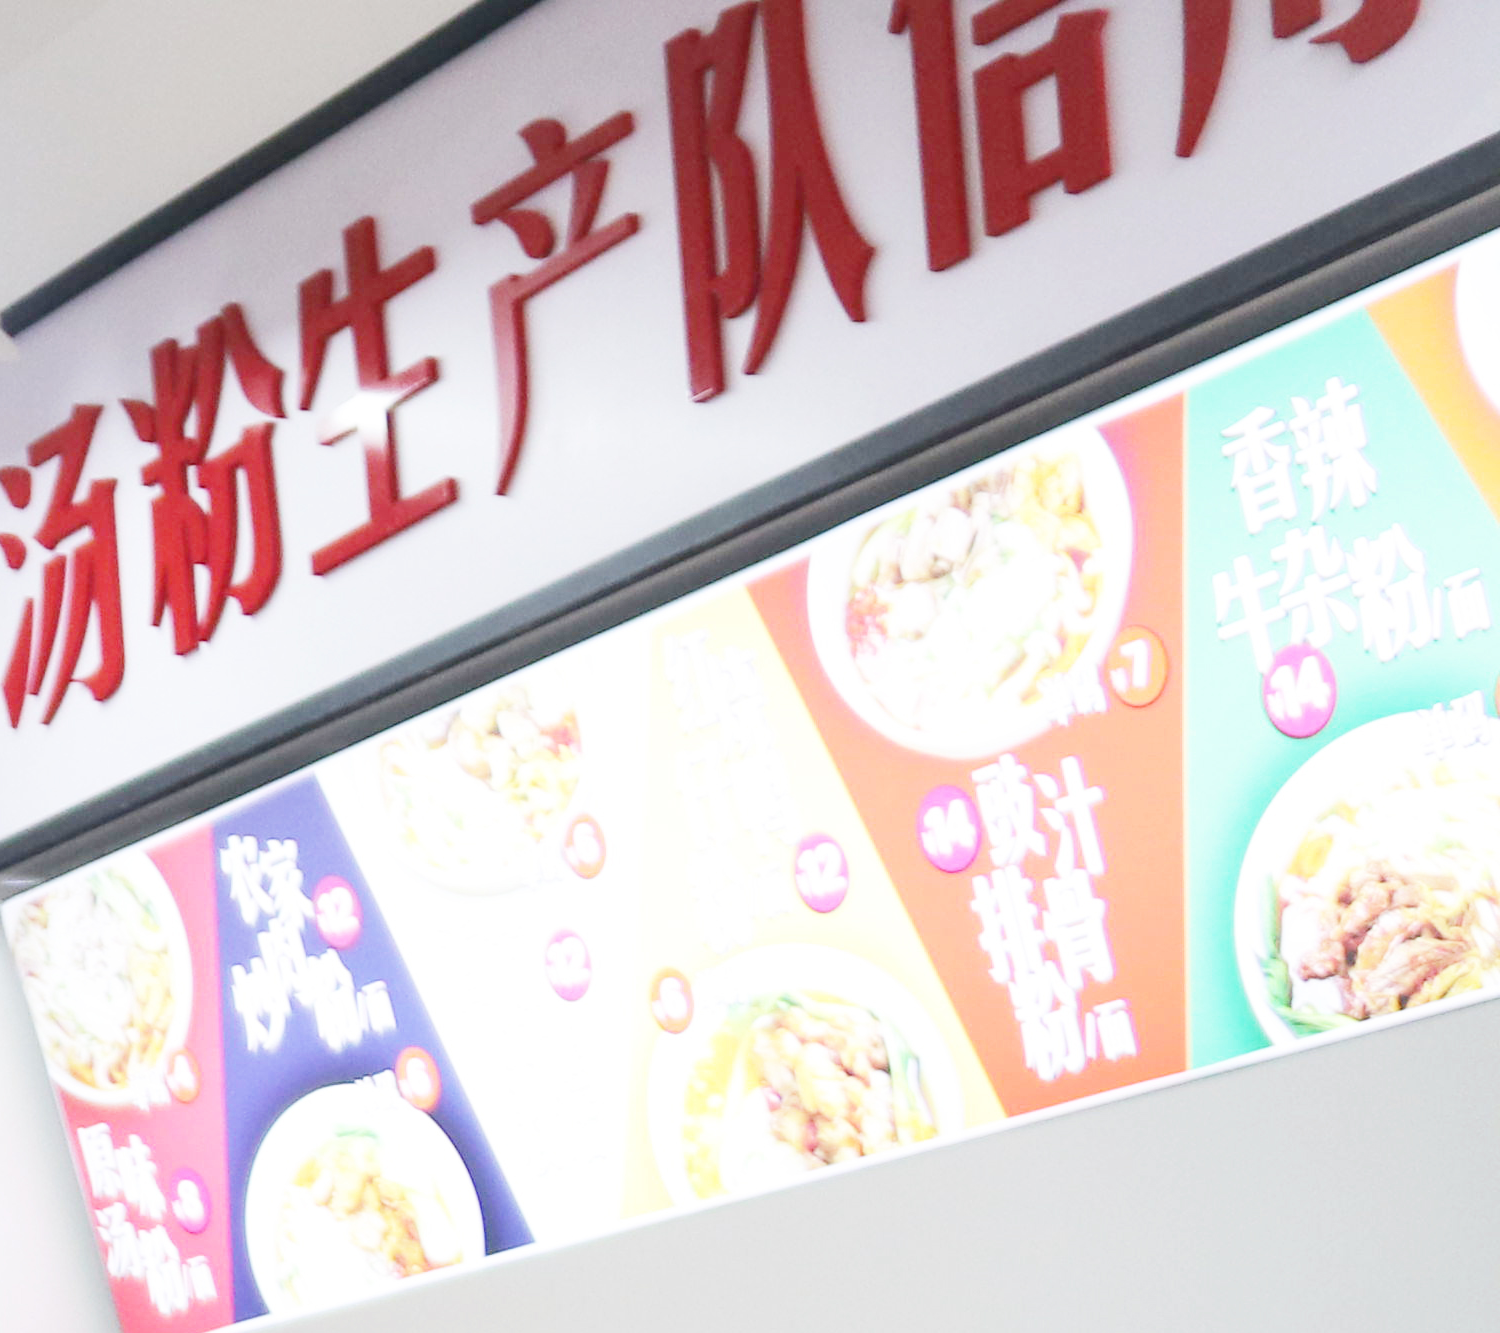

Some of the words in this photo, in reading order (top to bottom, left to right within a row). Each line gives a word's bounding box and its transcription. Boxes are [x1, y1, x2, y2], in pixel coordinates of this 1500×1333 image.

[1221, 376, 1378, 534] 香辣
[971, 753, 1105, 876] 豉汁
[220, 834, 315, 931] 农家
[970, 864, 1114, 990] 排骨
[77, 1123, 166, 1221] 原味
